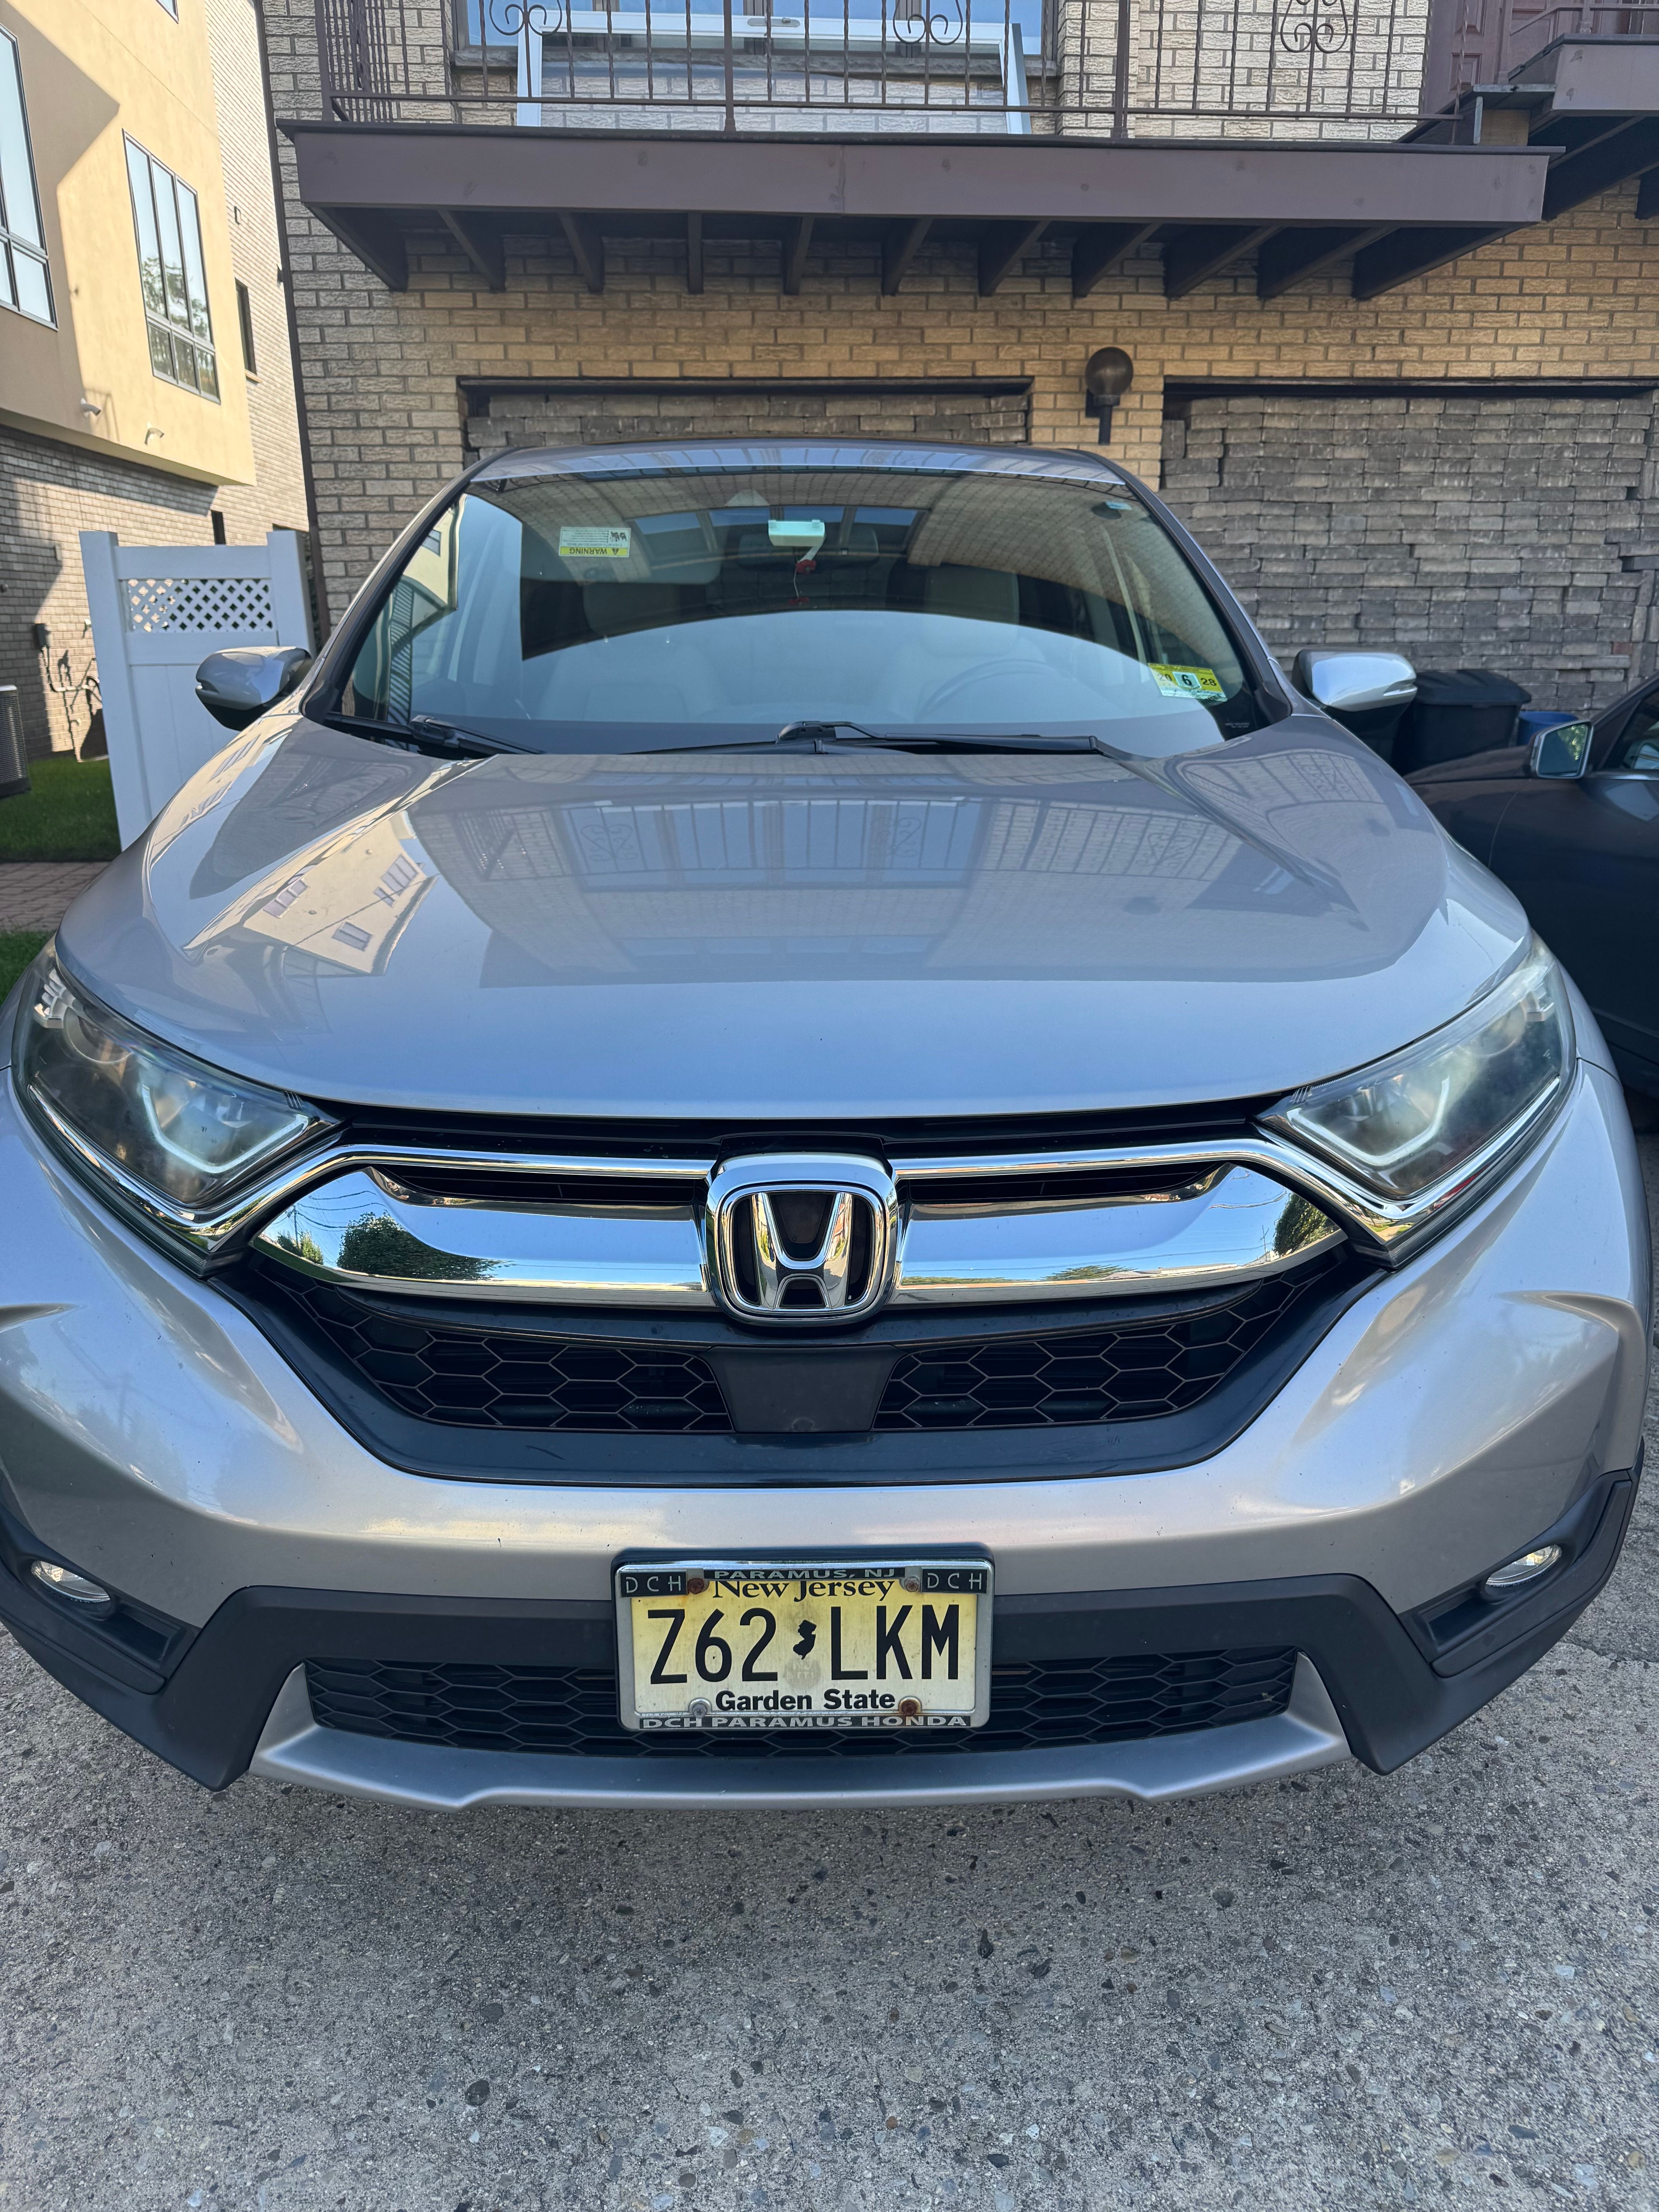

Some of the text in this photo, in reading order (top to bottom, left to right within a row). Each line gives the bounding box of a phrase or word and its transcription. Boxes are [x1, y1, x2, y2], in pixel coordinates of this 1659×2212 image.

[1182, 674, 1192, 686] 6
[1200, 678, 1217, 686] 28
[714, 1569, 895, 1579] PARAMUS, NJ
[712, 1580, 895, 1602] New Jersey
[647, 1604, 959, 1685] Z62 LKM
[715, 1688, 895, 1711] Garden State
[643, 1716, 967, 1728] DCH PARAMUS HONDA
